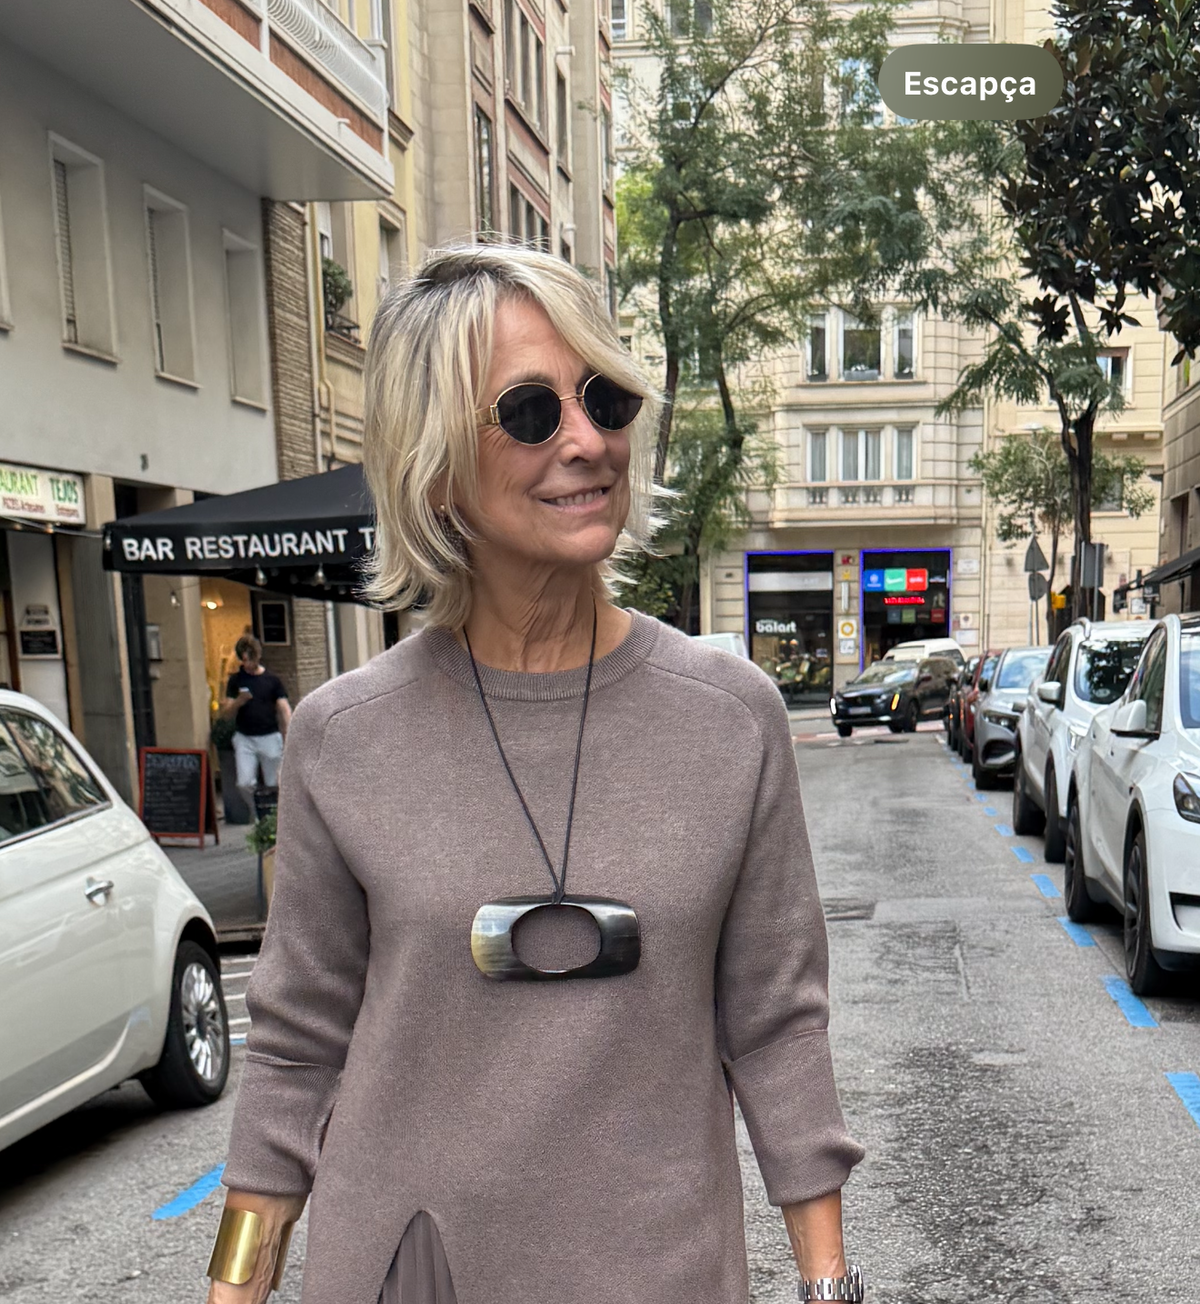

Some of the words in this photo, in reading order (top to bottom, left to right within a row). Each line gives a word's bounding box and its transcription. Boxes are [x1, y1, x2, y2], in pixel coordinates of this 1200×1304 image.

[49, 477, 79, 504] TEJOS
[121, 538, 175, 562] BAR
[184, 528, 349, 561] RESTAURANT
[755, 620, 797, 634] balart
